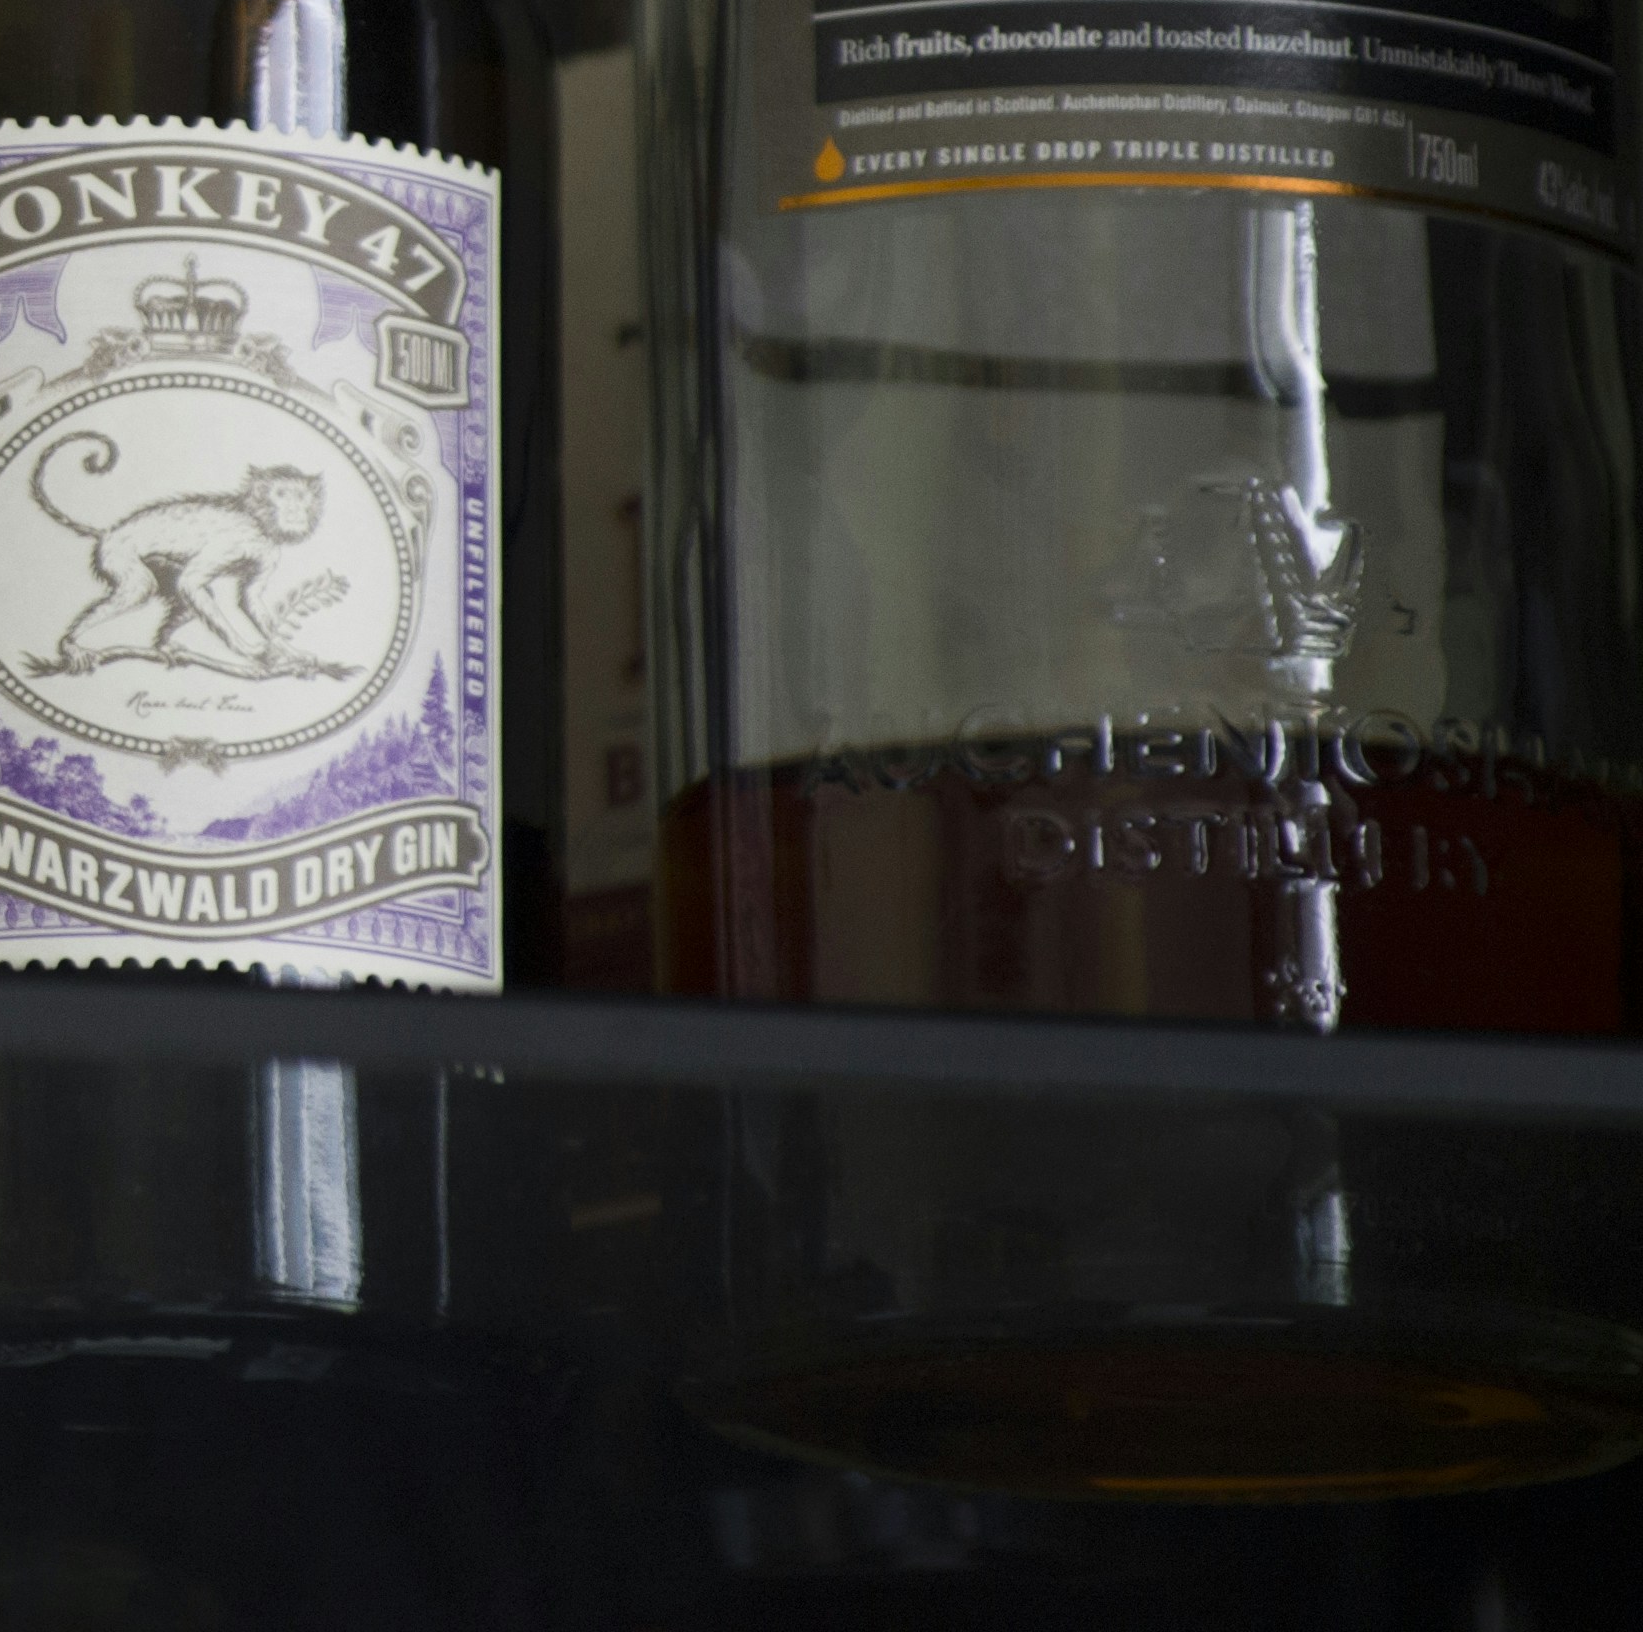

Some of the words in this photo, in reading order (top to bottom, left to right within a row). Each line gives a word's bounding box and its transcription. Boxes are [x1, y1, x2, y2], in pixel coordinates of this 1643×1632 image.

[839, 35, 890, 65] Rich
[894, 29, 972, 59] fruits,
[976, 22, 1102, 52] chocolate
[1107, 23, 1150, 48] and
[1156, 23, 1242, 53] toasted
[851, 149, 928, 178] EVERY
[937, 141, 1026, 168] SINGLE
[1034, 139, 1103, 164] DROP
[1114, 139, 1201, 164] TRIPLE
[1211, 140, 1336, 170] DISTILLED
[360, 222, 449, 294] 47
[466, 497, 485, 698] UNFILTERED
[303, 834, 383, 908] DRY
[393, 821, 459, 877] GIN
